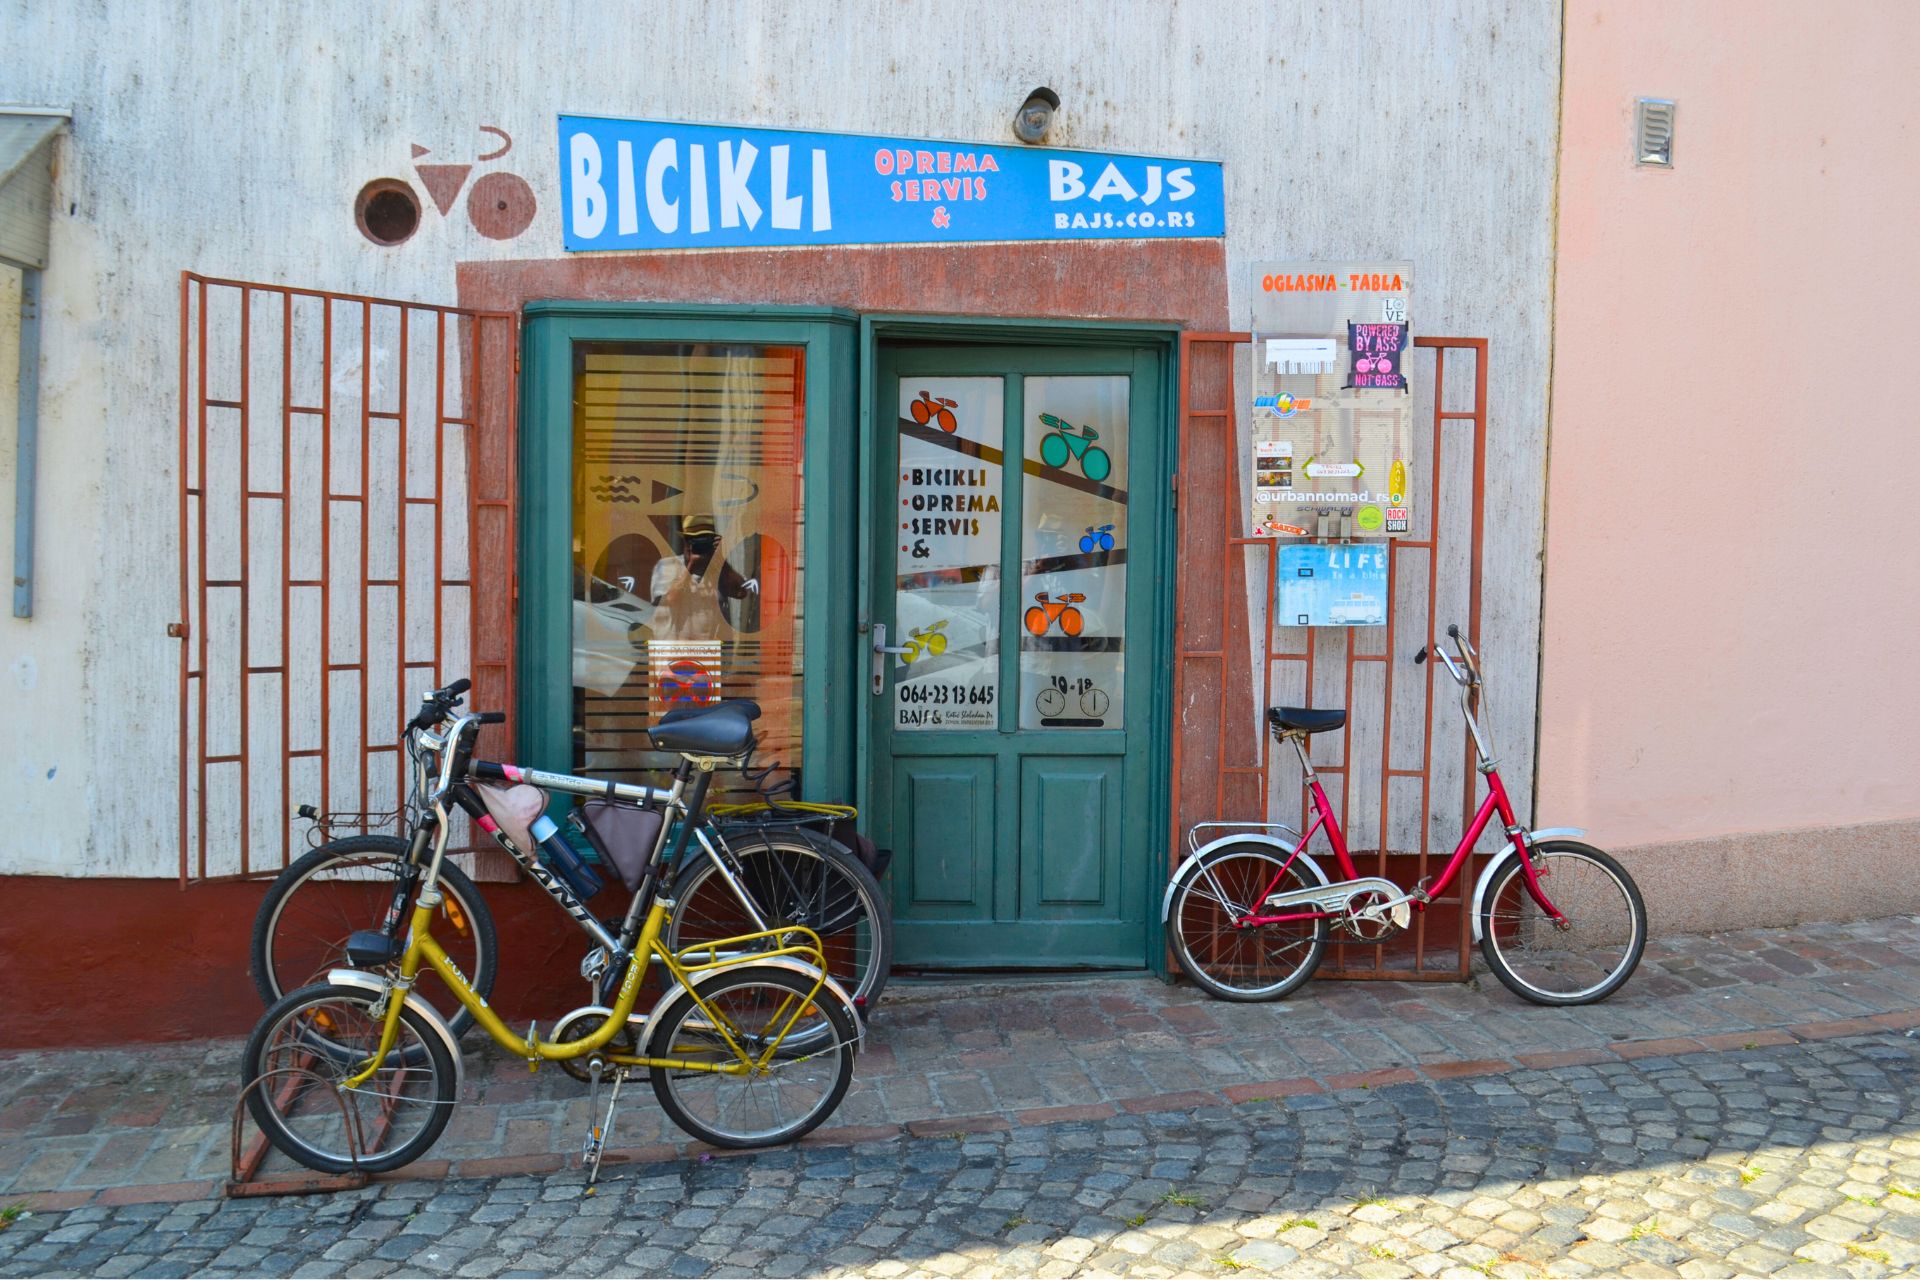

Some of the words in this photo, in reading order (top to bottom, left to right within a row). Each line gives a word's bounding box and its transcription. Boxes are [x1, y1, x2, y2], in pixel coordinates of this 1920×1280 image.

[874, 148, 1000, 176] OPREMA
[570, 132, 832, 239] BICIKLI
[890, 176, 988, 202] SERVIS
[1048, 159, 1196, 206] BAJS
[931, 205, 950, 229] &
[1054, 211, 1196, 230] BAJS.CO.RS
[1262, 273, 1337, 293] OGLASNA
[1350, 273, 1402, 292] TABLA
[1356, 324, 1399, 337] POWERED
[1356, 336, 1371, 352] BY
[1375, 336, 1397, 352] ASS
[1355, 374, 1372, 387] NOT
[1375, 374, 1398, 387] GASS
[912, 468, 986, 486] BICIKLI
[912, 494, 1000, 512] OPREMA
[1256, 490, 1389, 504] @urbannomad_rs
[1387, 509, 1406, 520] ROCK
[912, 518, 979, 536] SERVIS
[1387, 520, 1407, 531] SHOX
[912, 538, 930, 559] &
[1328, 552, 1385, 569] LIFE
[670, 646, 718, 656] PARKIRAJ
[900, 684, 948, 704] 064-23
[952, 685, 966, 704] 13
[969, 685, 994, 705] 645
[497, 832, 599, 925] GIANT
